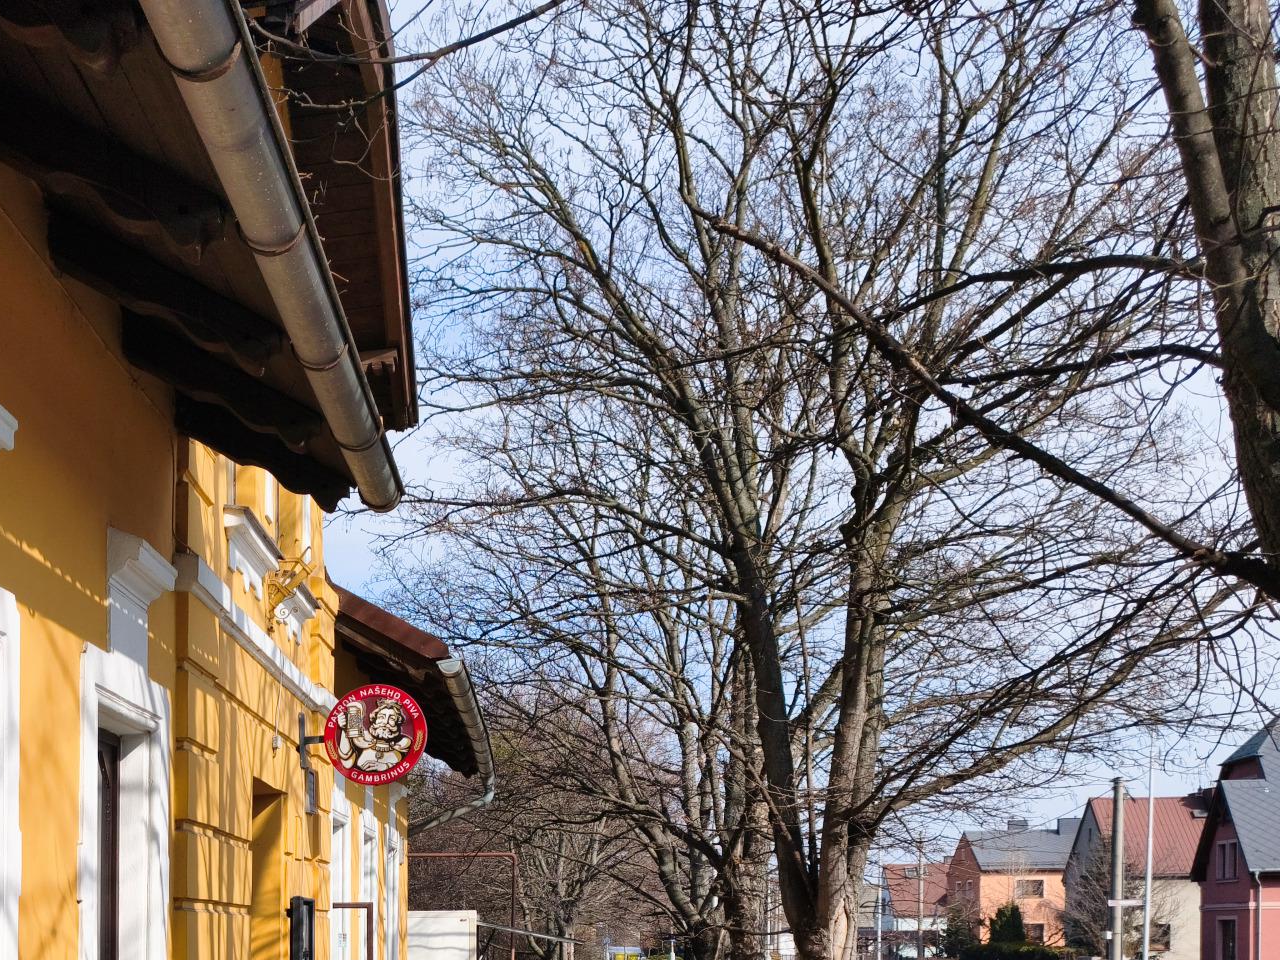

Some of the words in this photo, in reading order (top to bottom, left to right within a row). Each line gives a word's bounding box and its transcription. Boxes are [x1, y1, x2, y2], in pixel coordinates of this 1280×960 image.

[328, 695, 356, 728] PATRON
[360, 686, 401, 699] NAŠEHO
[403, 698, 420, 719] PIVA
[351, 761, 410, 782] GAMBRINUS
